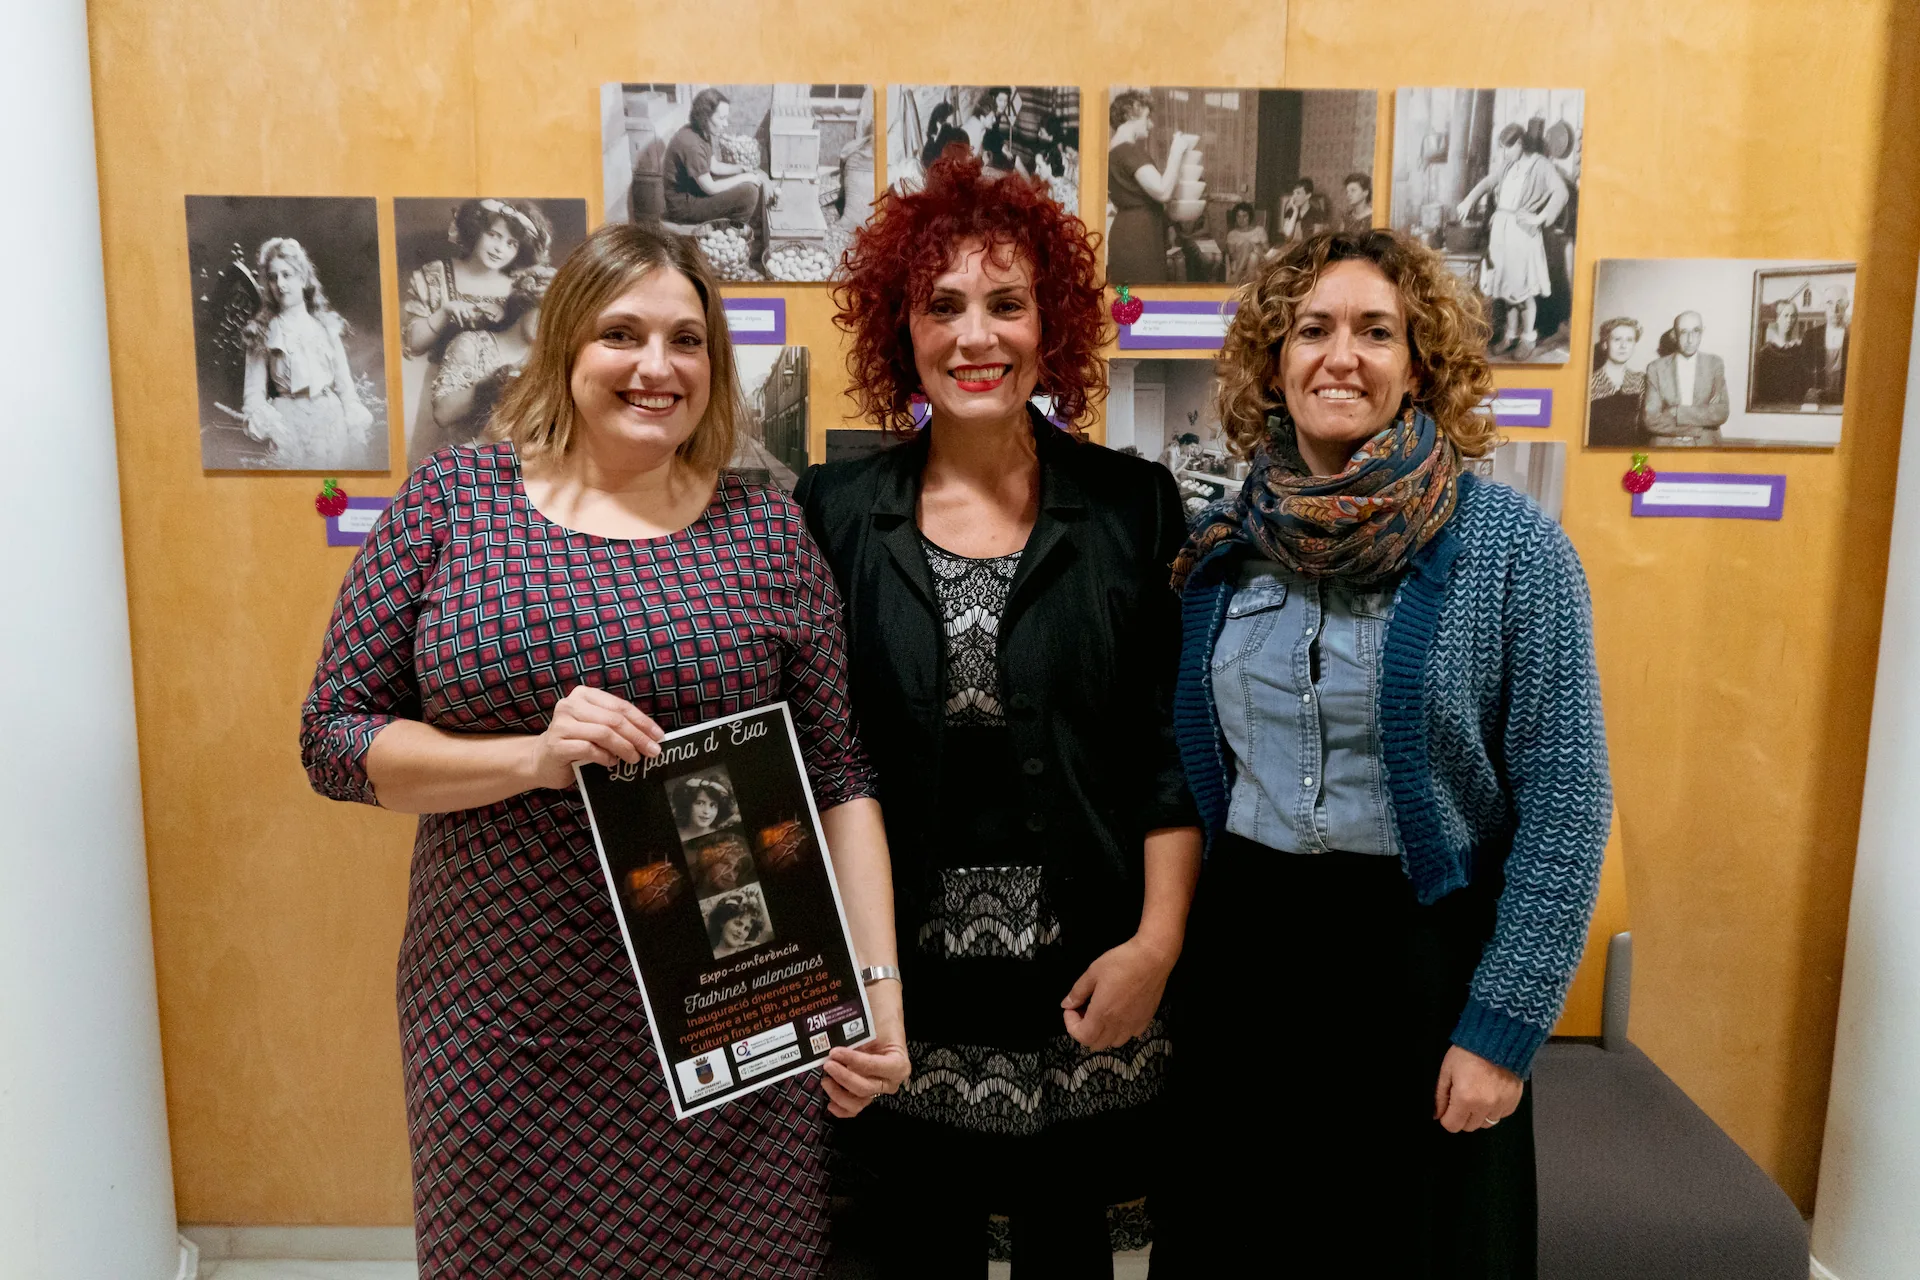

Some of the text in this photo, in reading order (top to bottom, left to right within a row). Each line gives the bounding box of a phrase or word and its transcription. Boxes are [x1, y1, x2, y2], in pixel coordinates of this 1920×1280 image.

[643, 741, 698, 779] poma
[684, 954, 824, 1015] Fadrines valencianes
[700, 942, 800, 986] Expo-conferència
[679, 979, 842, 1045] novembre a les 18h, a la Casa de
[687, 970, 829, 1028] Inauguració divendres 21 de
[691, 1033, 730, 1054] Cultura
[731, 1025, 751, 1040] fins
[753, 1019, 763, 1031] el
[763, 1016, 772, 1028] 5
[773, 1010, 787, 1023] de
[788, 993, 839, 1018] desembre
[807, 1012, 828, 1032] 25N
